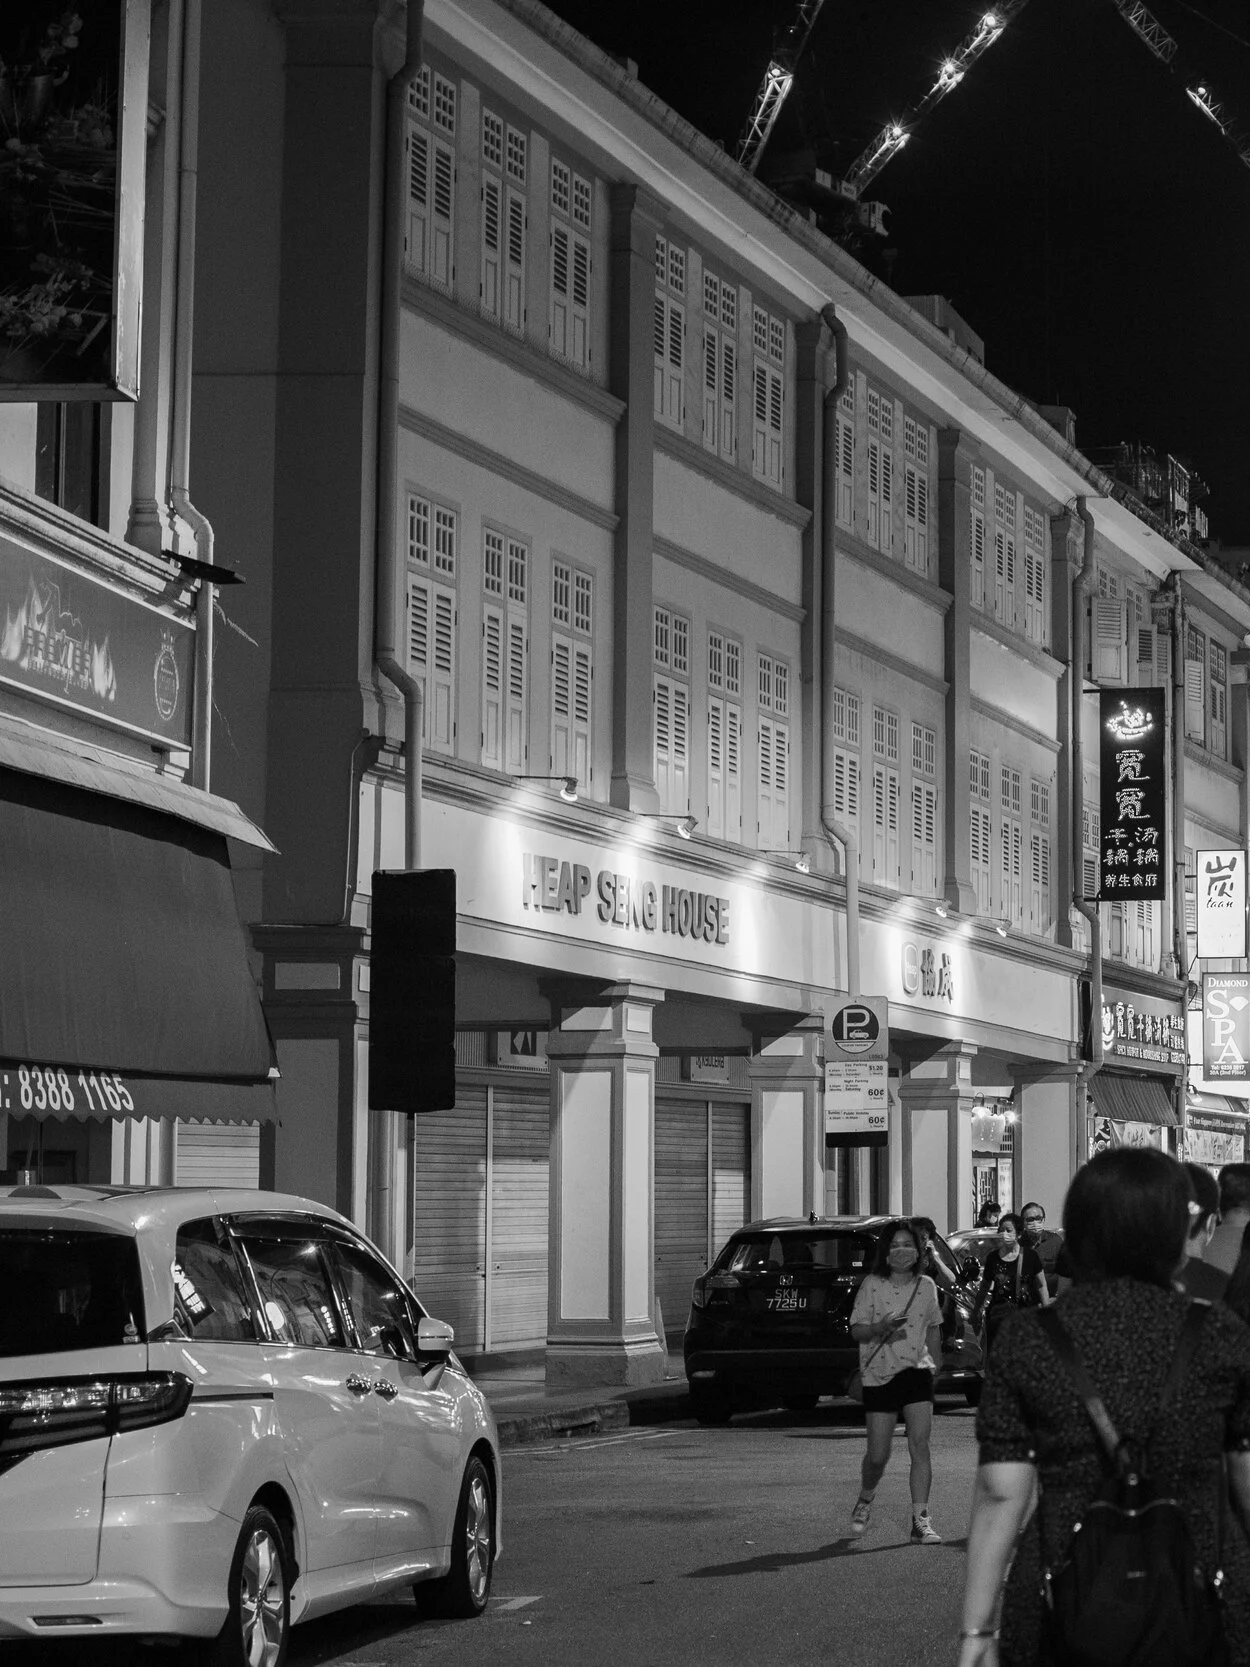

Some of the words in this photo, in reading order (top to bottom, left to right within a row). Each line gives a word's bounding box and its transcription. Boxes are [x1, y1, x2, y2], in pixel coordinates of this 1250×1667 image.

[523, 853, 591, 915] HEAP
[597, 870, 657, 931] SENG
[662, 885, 730, 944] HOUSE
[1208, 977, 1248, 988] DIAMOND
[843, 1009, 870, 1040] P
[1206, 989, 1249, 1064] SPA
[18, 1064, 75, 1110] 8388
[78, 1069, 134, 1111] 1165
[766, 1297, 807, 1309] 7725U
[775, 1288, 799, 1299] SKW
